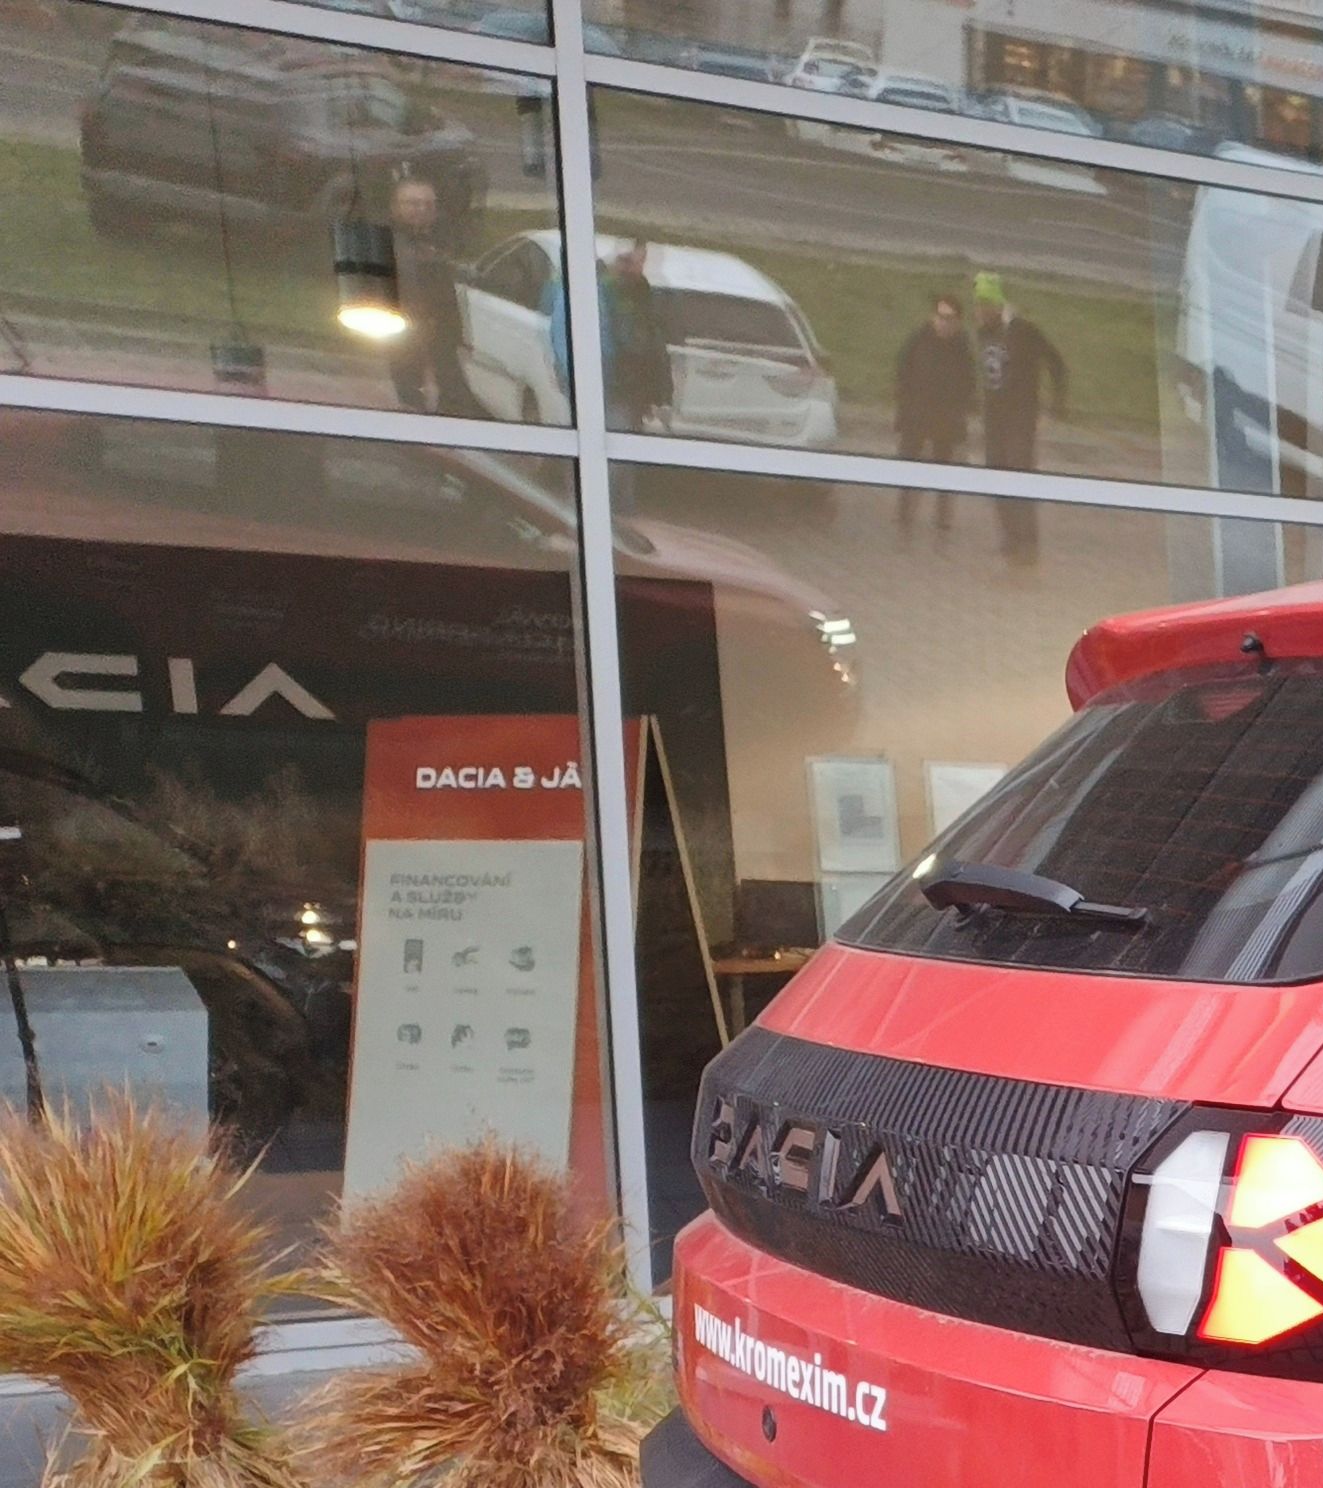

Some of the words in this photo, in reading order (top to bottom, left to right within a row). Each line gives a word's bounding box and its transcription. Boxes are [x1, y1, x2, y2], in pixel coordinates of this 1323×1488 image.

[416, 766, 506, 788] DACIA
[513, 767, 535, 788] &
[388, 872, 512, 888] FINANCOVÁNÍ
[388, 908, 413, 921] NA
[694, 1303, 888, 1431] www.kromexim.cz
